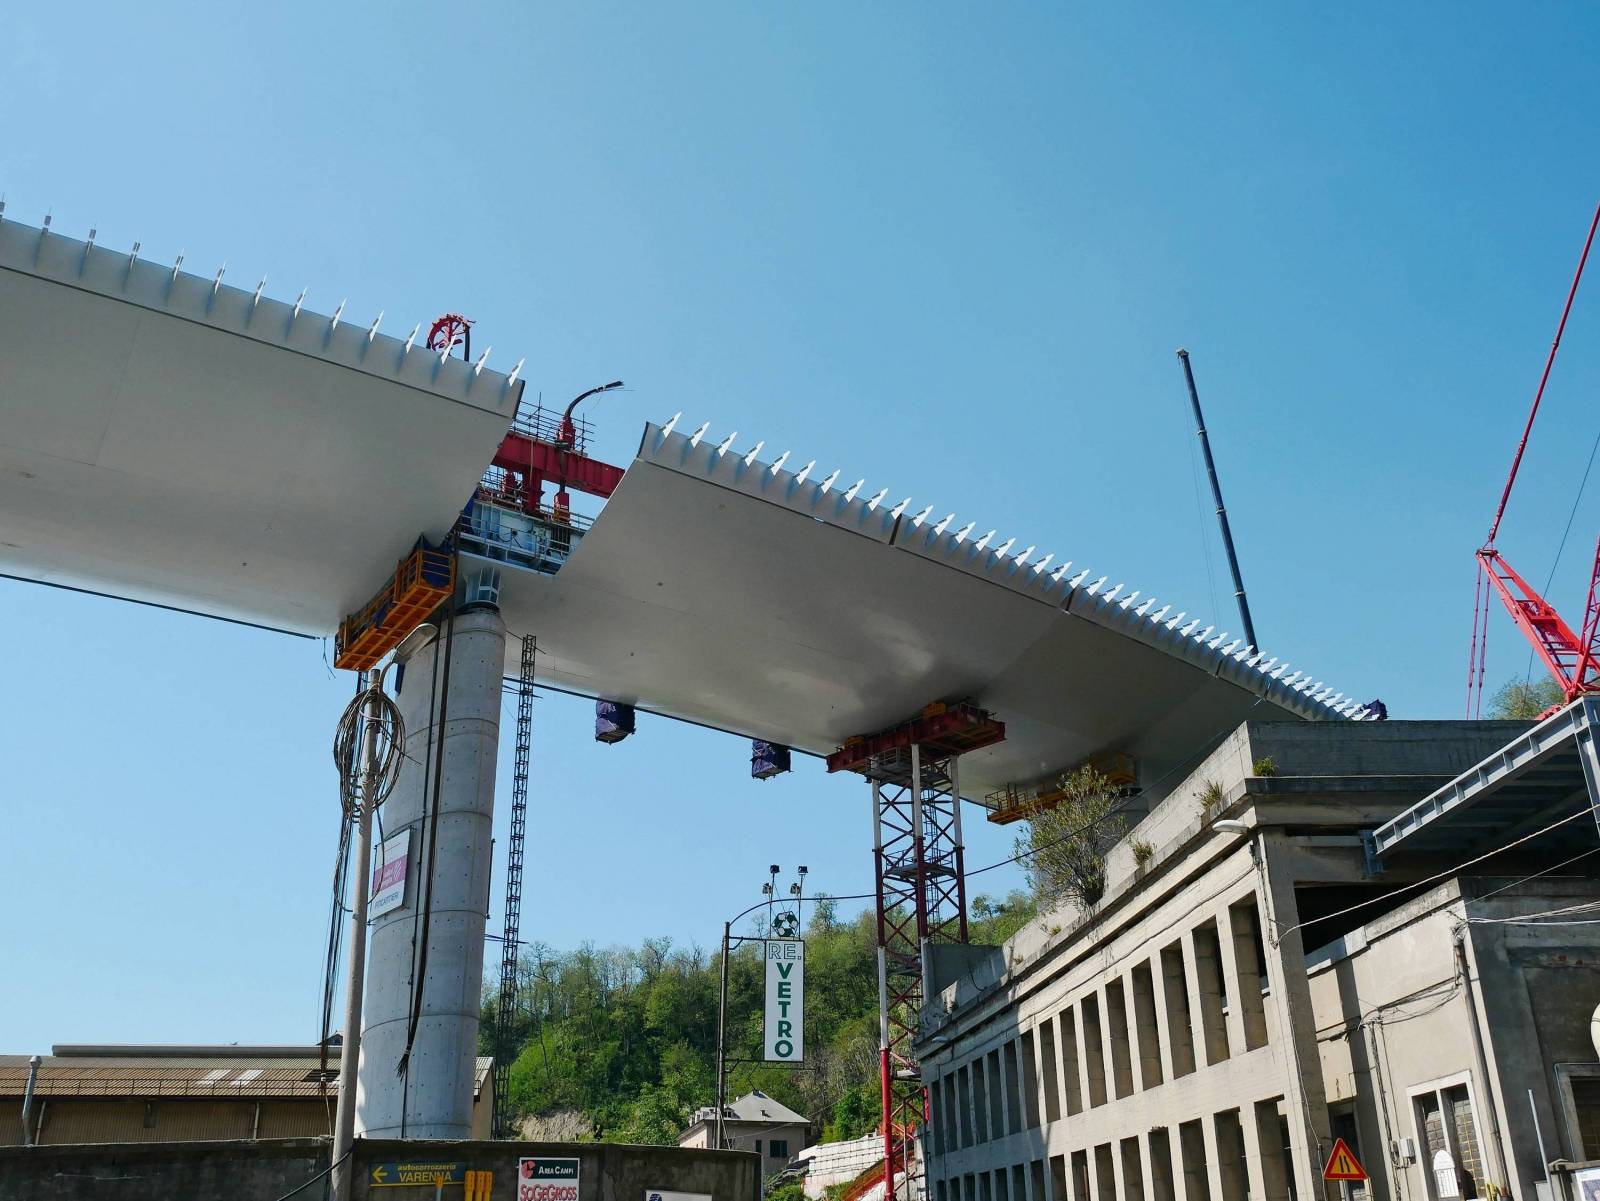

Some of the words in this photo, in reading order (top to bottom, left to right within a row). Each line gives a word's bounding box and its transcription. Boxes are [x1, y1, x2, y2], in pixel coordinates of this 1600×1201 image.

[768, 942, 802, 960] RE.
[774, 962, 794, 1058] VETRO
[397, 1163, 456, 1171] autocarrozzeria
[398, 1171, 452, 1182] VARENNA
